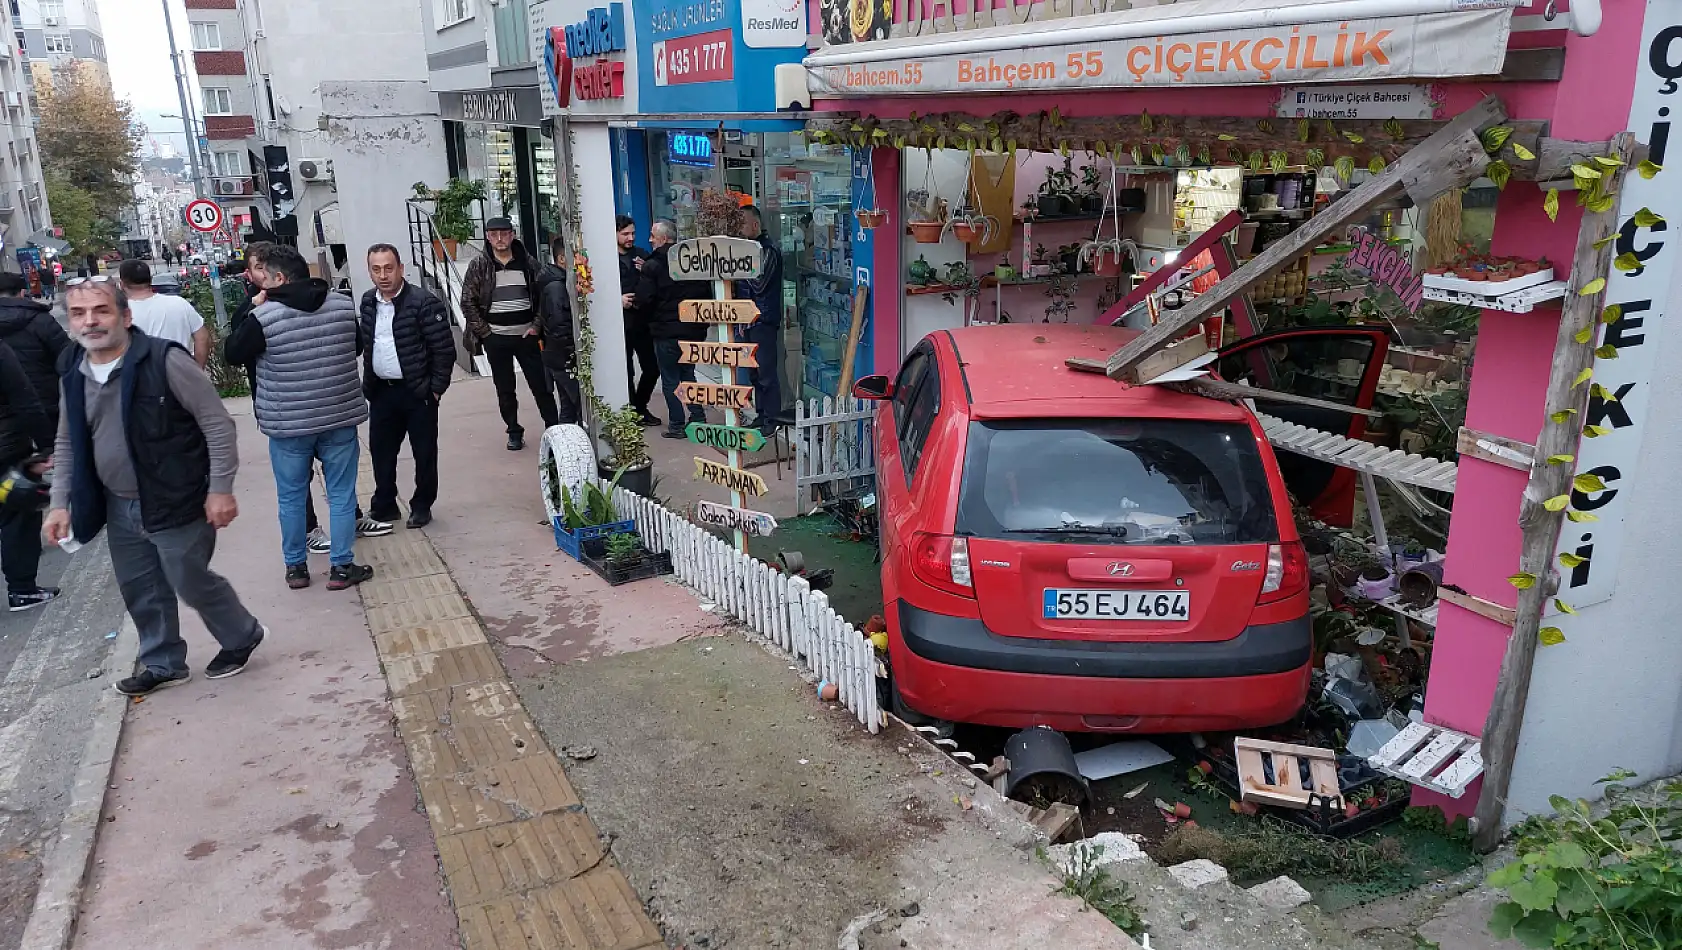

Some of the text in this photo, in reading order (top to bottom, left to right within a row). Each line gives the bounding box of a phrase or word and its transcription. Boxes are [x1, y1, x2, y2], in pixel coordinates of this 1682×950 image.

[748, 17, 799, 30] ResMed
[670, 41, 726, 76] 435 1 777
[1126, 22, 1394, 83] ÇİÇEKÇİLİK
[957, 51, 1104, 88] Bahçem 55
[1313, 92, 1344, 104] Türkiye
[192, 207, 216, 224] 30
[691, 302, 738, 322] Kaktüs
[688, 343, 743, 367] BUKET
[1046, 604, 1057, 613] TR
[1058, 592, 1188, 617] 55 EJ 464
